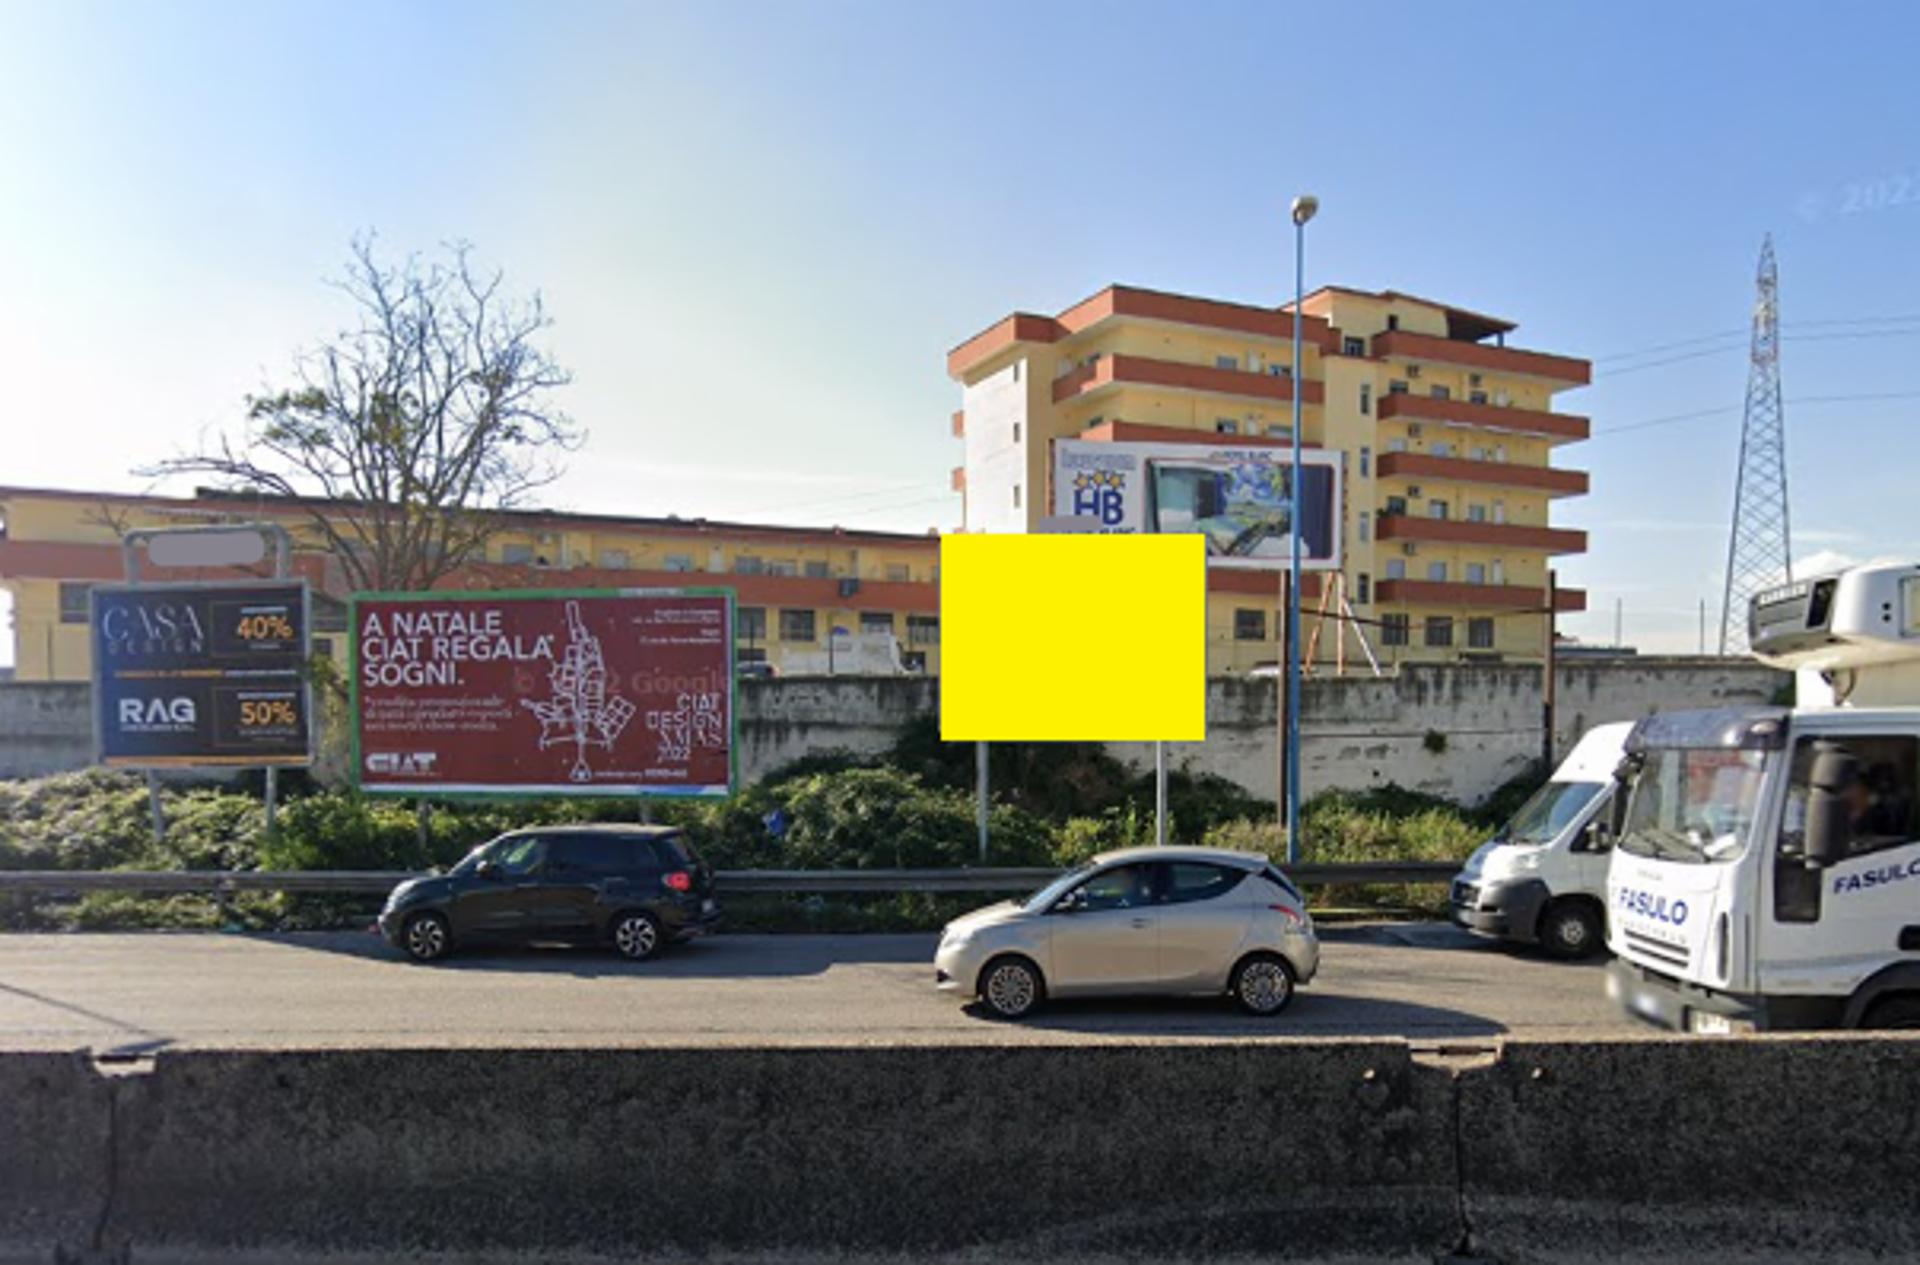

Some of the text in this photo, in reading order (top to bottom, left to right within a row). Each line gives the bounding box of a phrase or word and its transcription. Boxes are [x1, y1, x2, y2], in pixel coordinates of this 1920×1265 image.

[1073, 490, 1124, 525] HB
[103, 605, 204, 641] CASA
[236, 615, 294, 639] 40%
[363, 610, 502, 636] A NATALE
[362, 637, 423, 661] CIAT
[364, 663, 465, 687] SOGNI.
[119, 698, 196, 724] RAG
[676, 693, 721, 709] CIAT
[239, 702, 296, 725] 50%
[646, 711, 723, 728] DESIGN
[1617, 882, 1689, 926] FASULO
